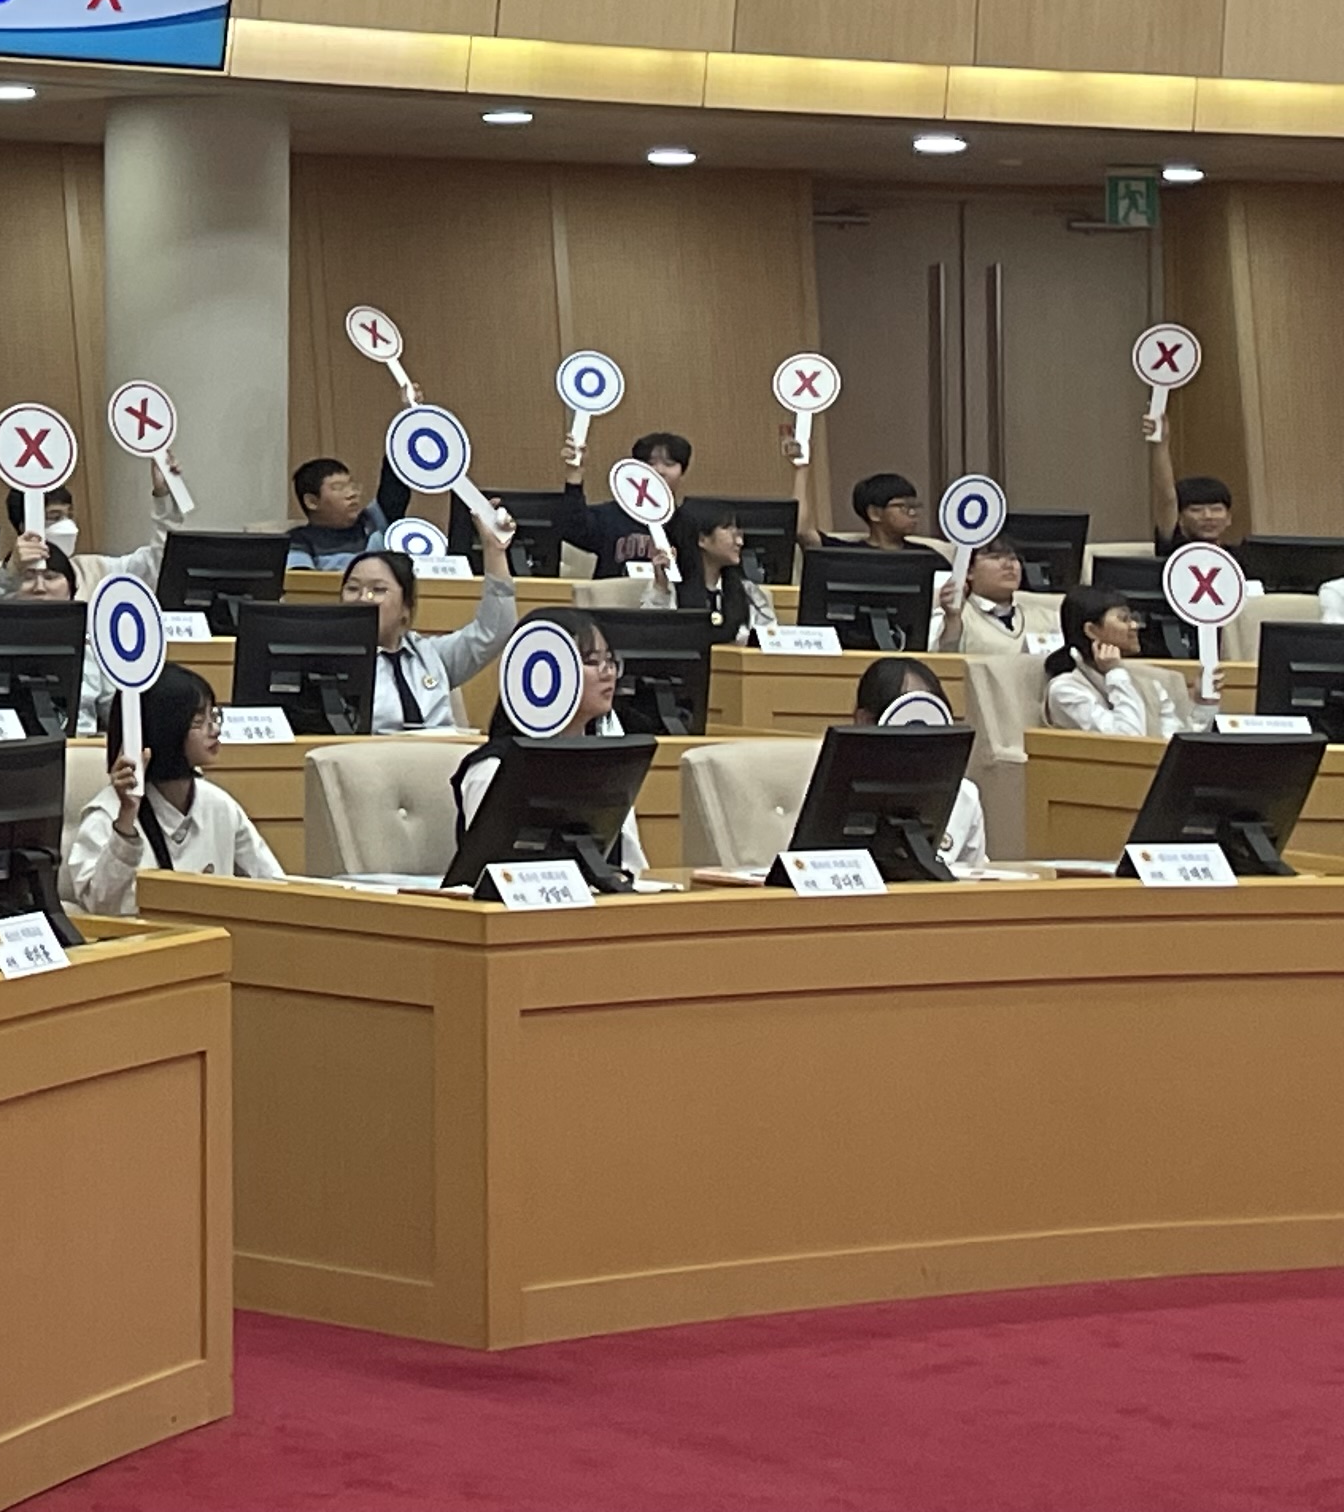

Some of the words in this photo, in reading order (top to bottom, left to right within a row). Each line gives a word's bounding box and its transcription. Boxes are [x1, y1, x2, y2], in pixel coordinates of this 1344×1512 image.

[359, 319, 391, 348] X
[1151, 341, 1183, 372] X
[574, 367, 606, 397] O
[793, 369, 822, 397] X
[124, 398, 163, 440] X
[14, 427, 54, 470] X
[408, 428, 449, 470] O
[626, 477, 661, 508] X
[957, 493, 988, 529] O
[1188, 565, 1223, 605] X
[109, 601, 146, 662] O
[522, 650, 562, 707] O
